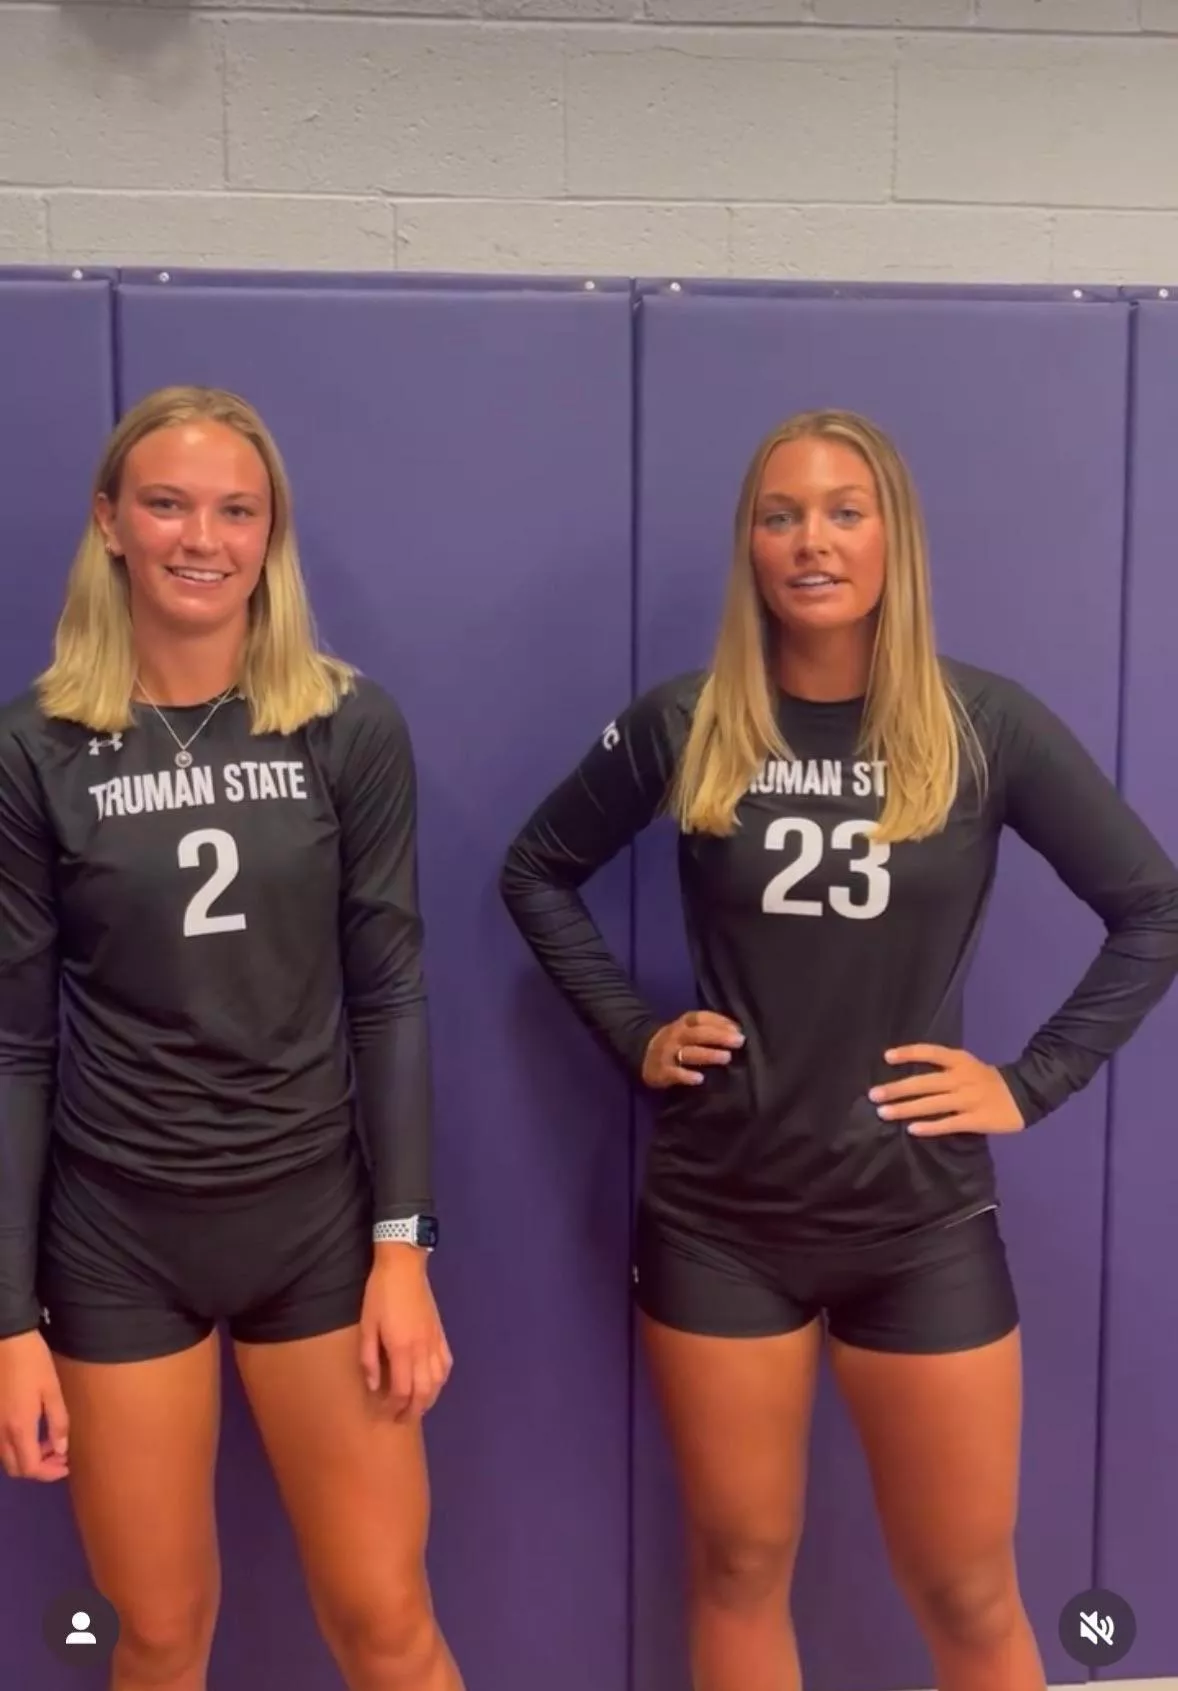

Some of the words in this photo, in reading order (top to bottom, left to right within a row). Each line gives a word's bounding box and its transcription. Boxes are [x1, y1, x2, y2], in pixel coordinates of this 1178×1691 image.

[88, 765, 215, 821] TRUMAN
[223, 760, 307, 803] STATE
[177, 828, 247, 938] 2
[761, 816, 891, 920] 23
